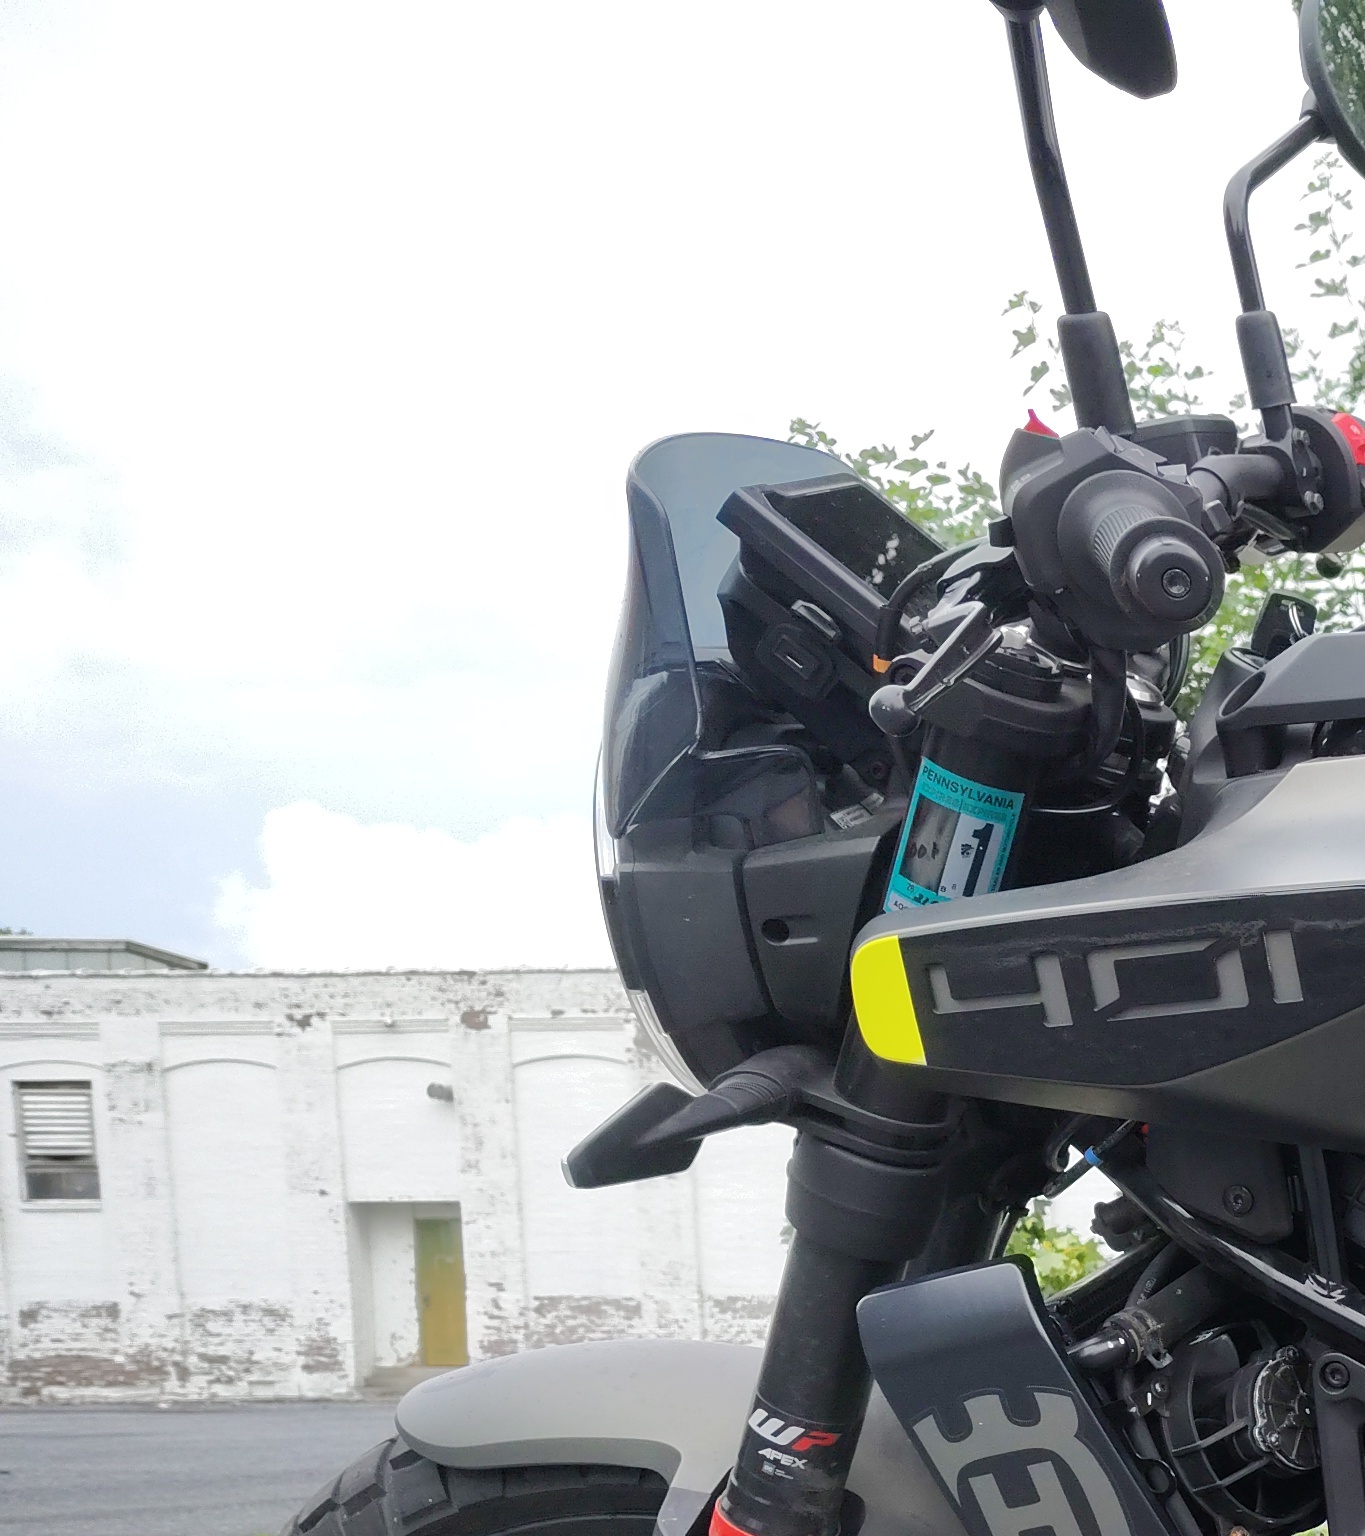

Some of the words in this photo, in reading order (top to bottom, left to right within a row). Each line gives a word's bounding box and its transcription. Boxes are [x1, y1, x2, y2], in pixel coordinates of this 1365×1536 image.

[921, 766, 1015, 810] PENNSYLVANIA
[961, 822, 995, 898] 1
[927, 930, 1304, 1028] 401
[748, 1408, 842, 1452] WP
[757, 1447, 808, 1470] APEX
